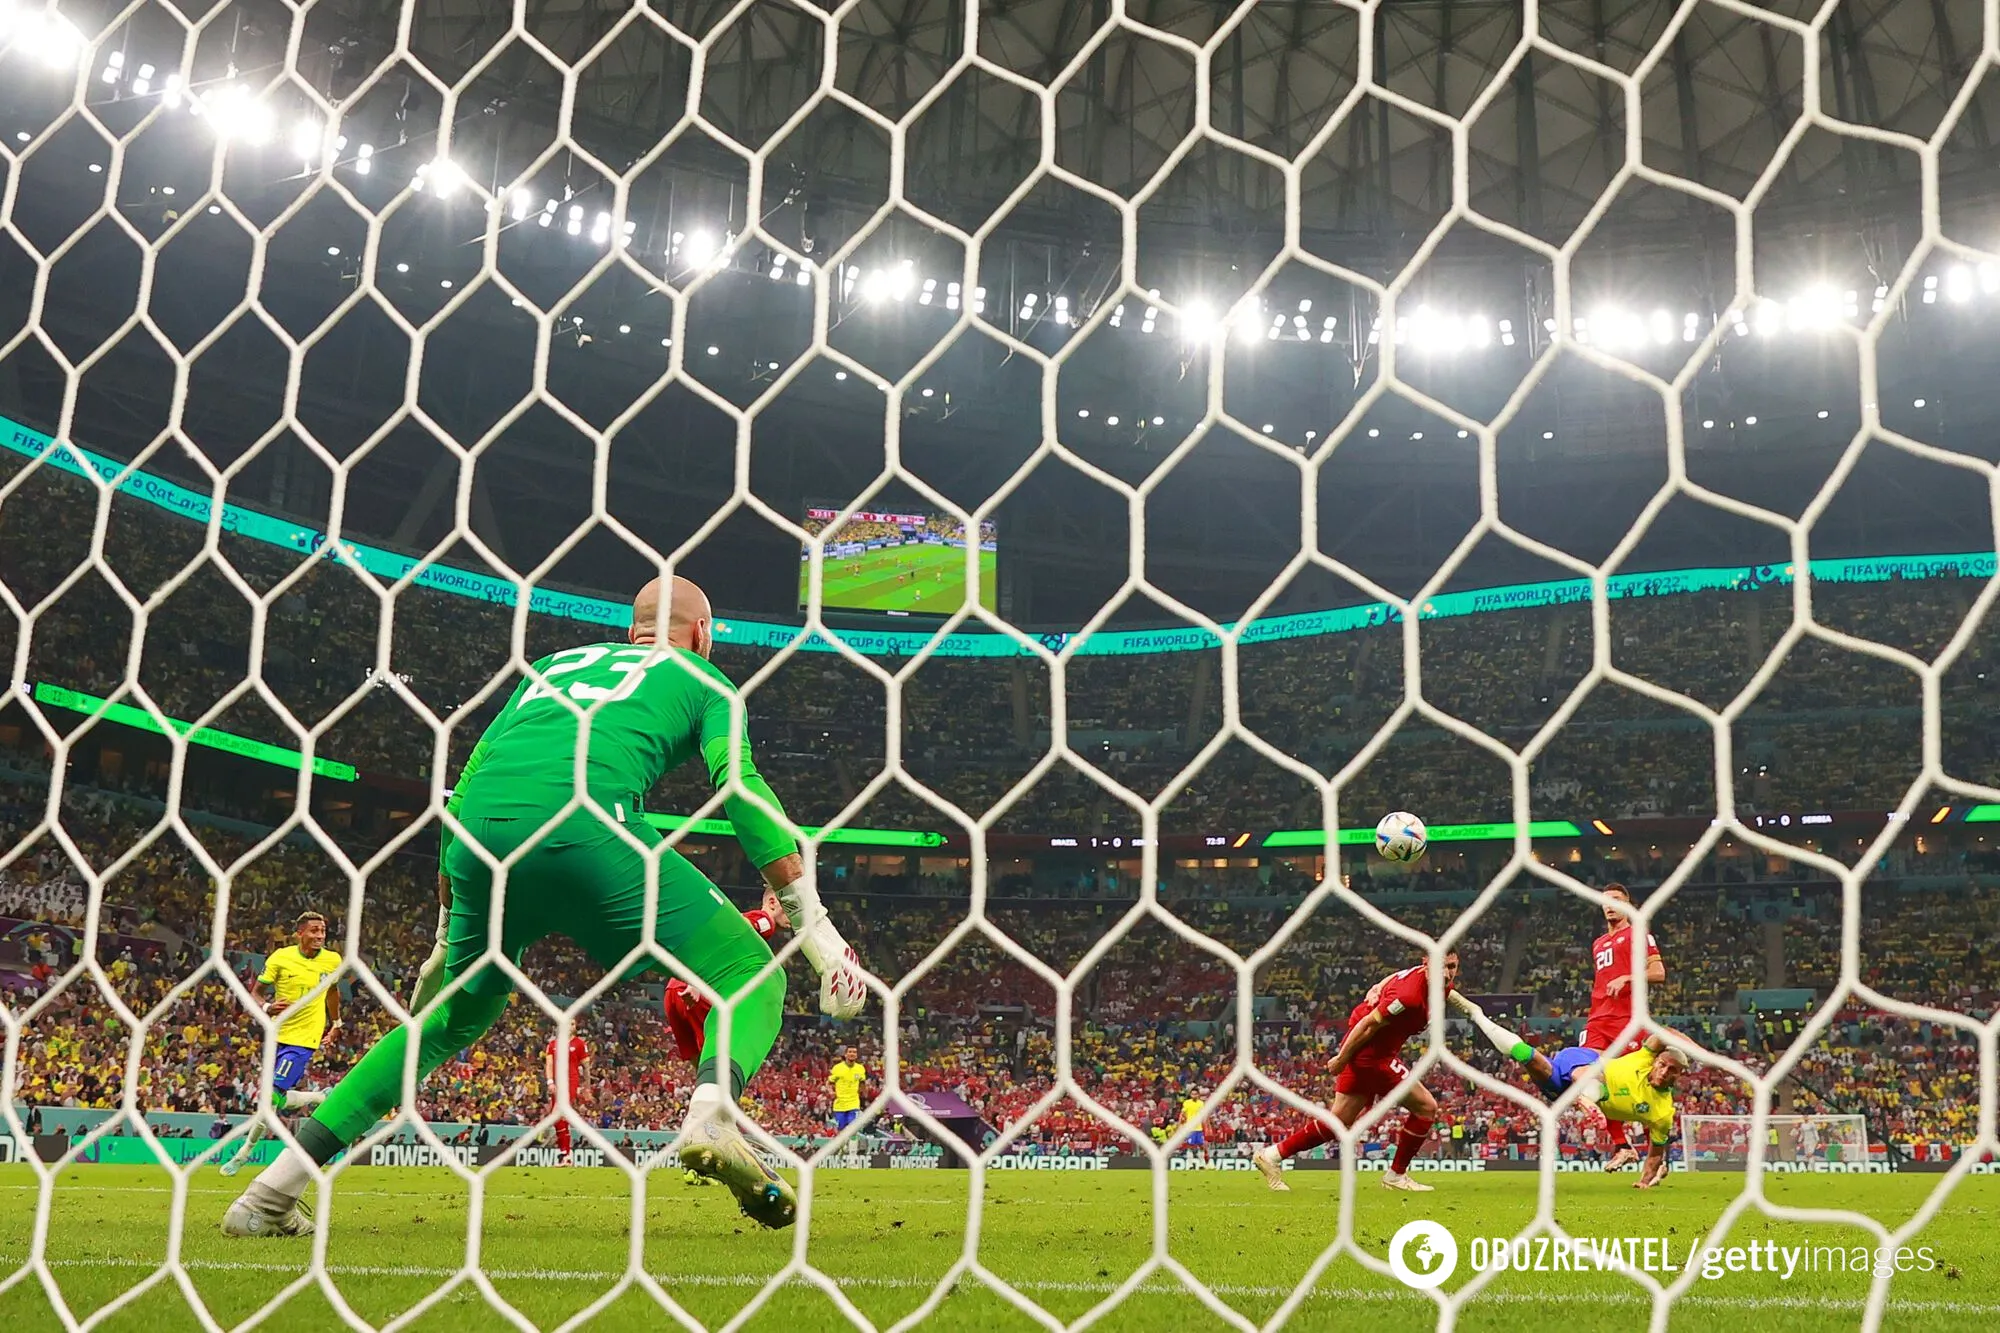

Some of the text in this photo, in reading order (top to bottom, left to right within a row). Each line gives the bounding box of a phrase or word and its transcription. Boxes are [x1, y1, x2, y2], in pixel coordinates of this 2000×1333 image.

[13, 432, 45, 453] FIFA
[1844, 565, 1873, 577] FIFA
[401, 564, 430, 580] FA
[433, 571, 482, 591] WORLD
[484, 584, 511, 598] CUP
[1475, 593, 1501, 606] FIFA
[1504, 588, 1552, 601] WORLD
[769, 631, 796, 643] FIFA
[848, 636, 874, 648] CUP
[1123, 637, 1151, 648] FIFA
[1152, 633, 1199, 646] WORLD
[516, 647, 671, 711] 23
[1756, 815, 1763, 827] 1
[1780, 815, 1791, 826] 0
[1090, 837, 1097, 847] 1
[1112, 837, 1122, 847] 0
[1596, 947, 1614, 971] 20
[276, 1059, 294, 1078] 11
[1389, 1058, 1410, 1080] 5
[371, 1144, 480, 1167] POWERDE
[986, 1154, 1110, 1170] POWERADE
[1170, 1157, 1295, 1171] POWERE
[1357, 1159, 1487, 1172] POERADE
